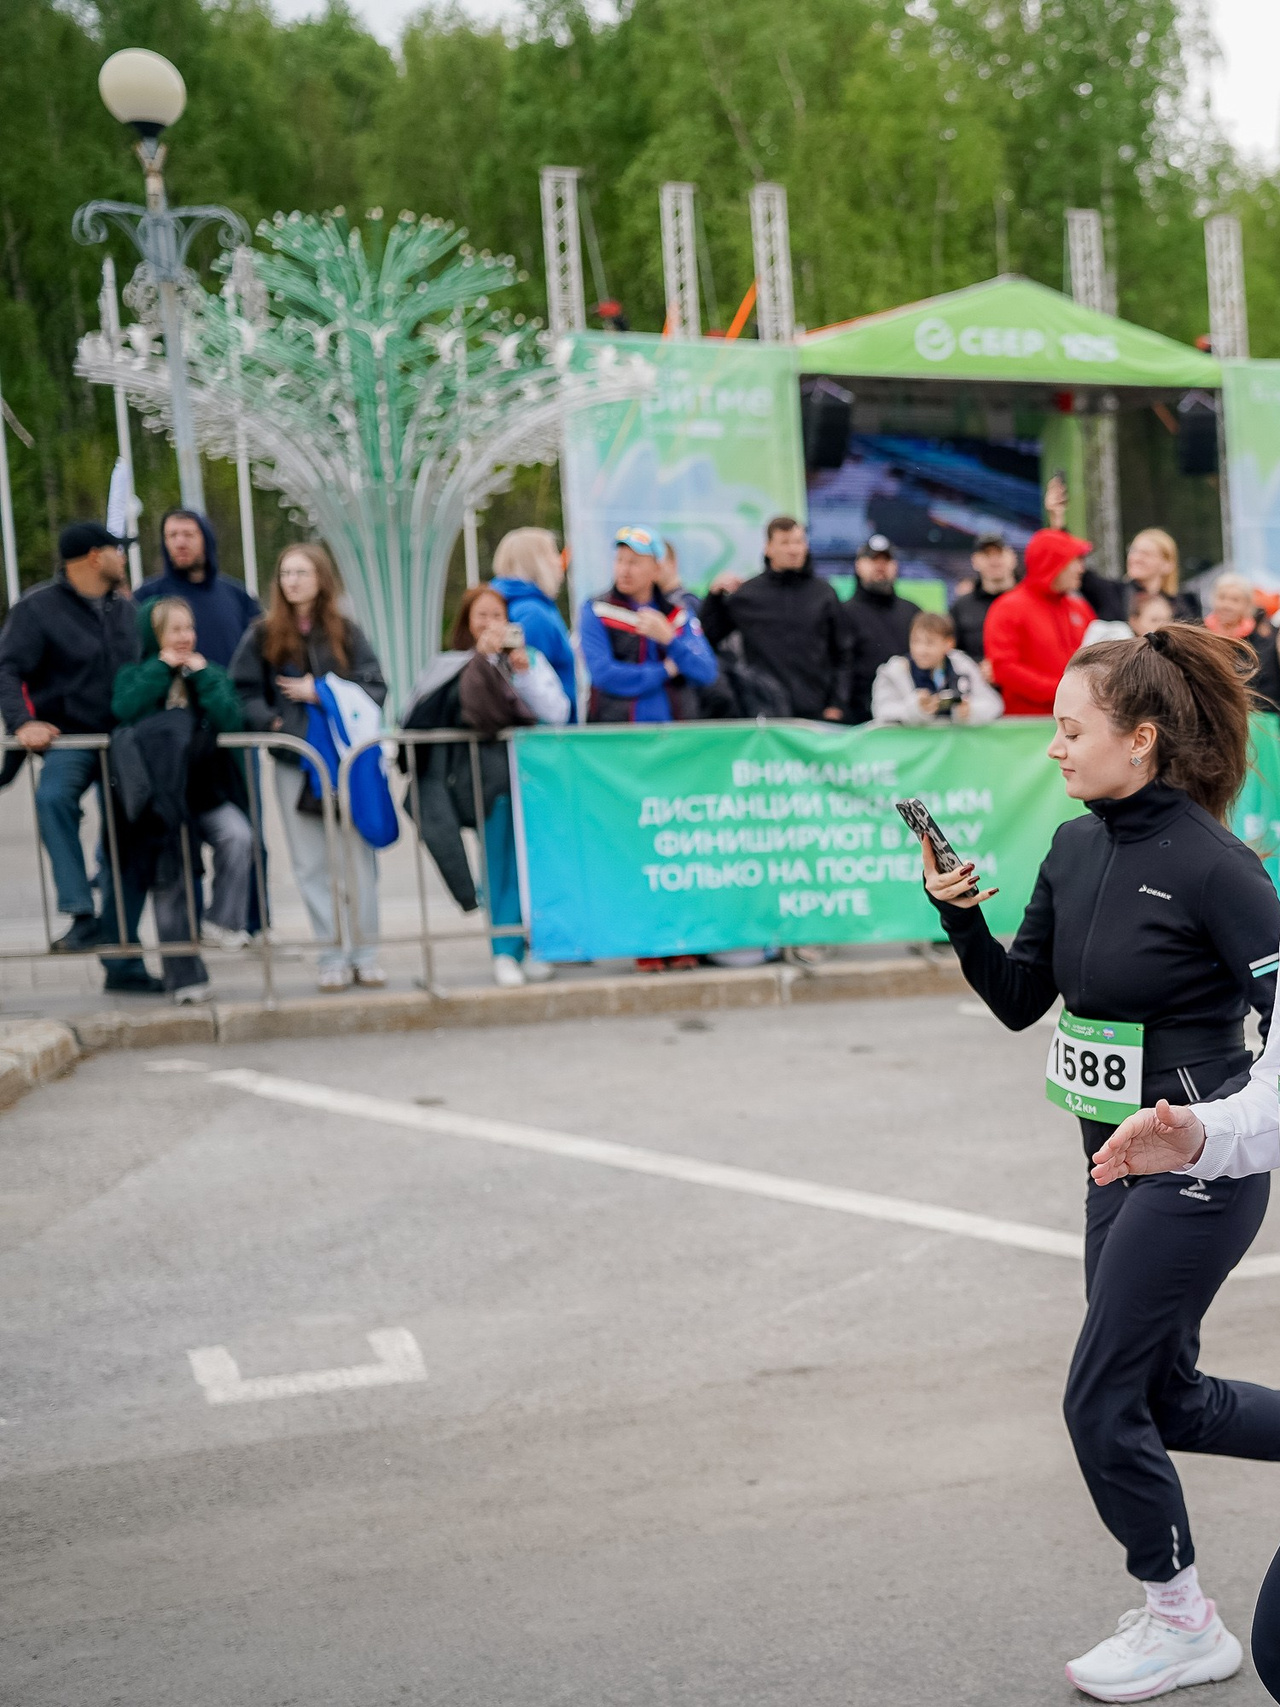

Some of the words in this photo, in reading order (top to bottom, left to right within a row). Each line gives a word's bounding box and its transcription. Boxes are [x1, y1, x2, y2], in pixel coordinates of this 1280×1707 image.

[732, 759, 897, 787] ВНИМАНИЕ
[638, 792, 823, 828] ДИСТАНЦИИ
[654, 822, 875, 857] ФИНИШИРУЮТ
[880, 823, 900, 850] В
[642, 858, 764, 892] ТОЛЬКО
[768, 857, 813, 885] НА
[779, 888, 871, 917] КРУГЕ
[1053, 1037, 1126, 1091] 1588
